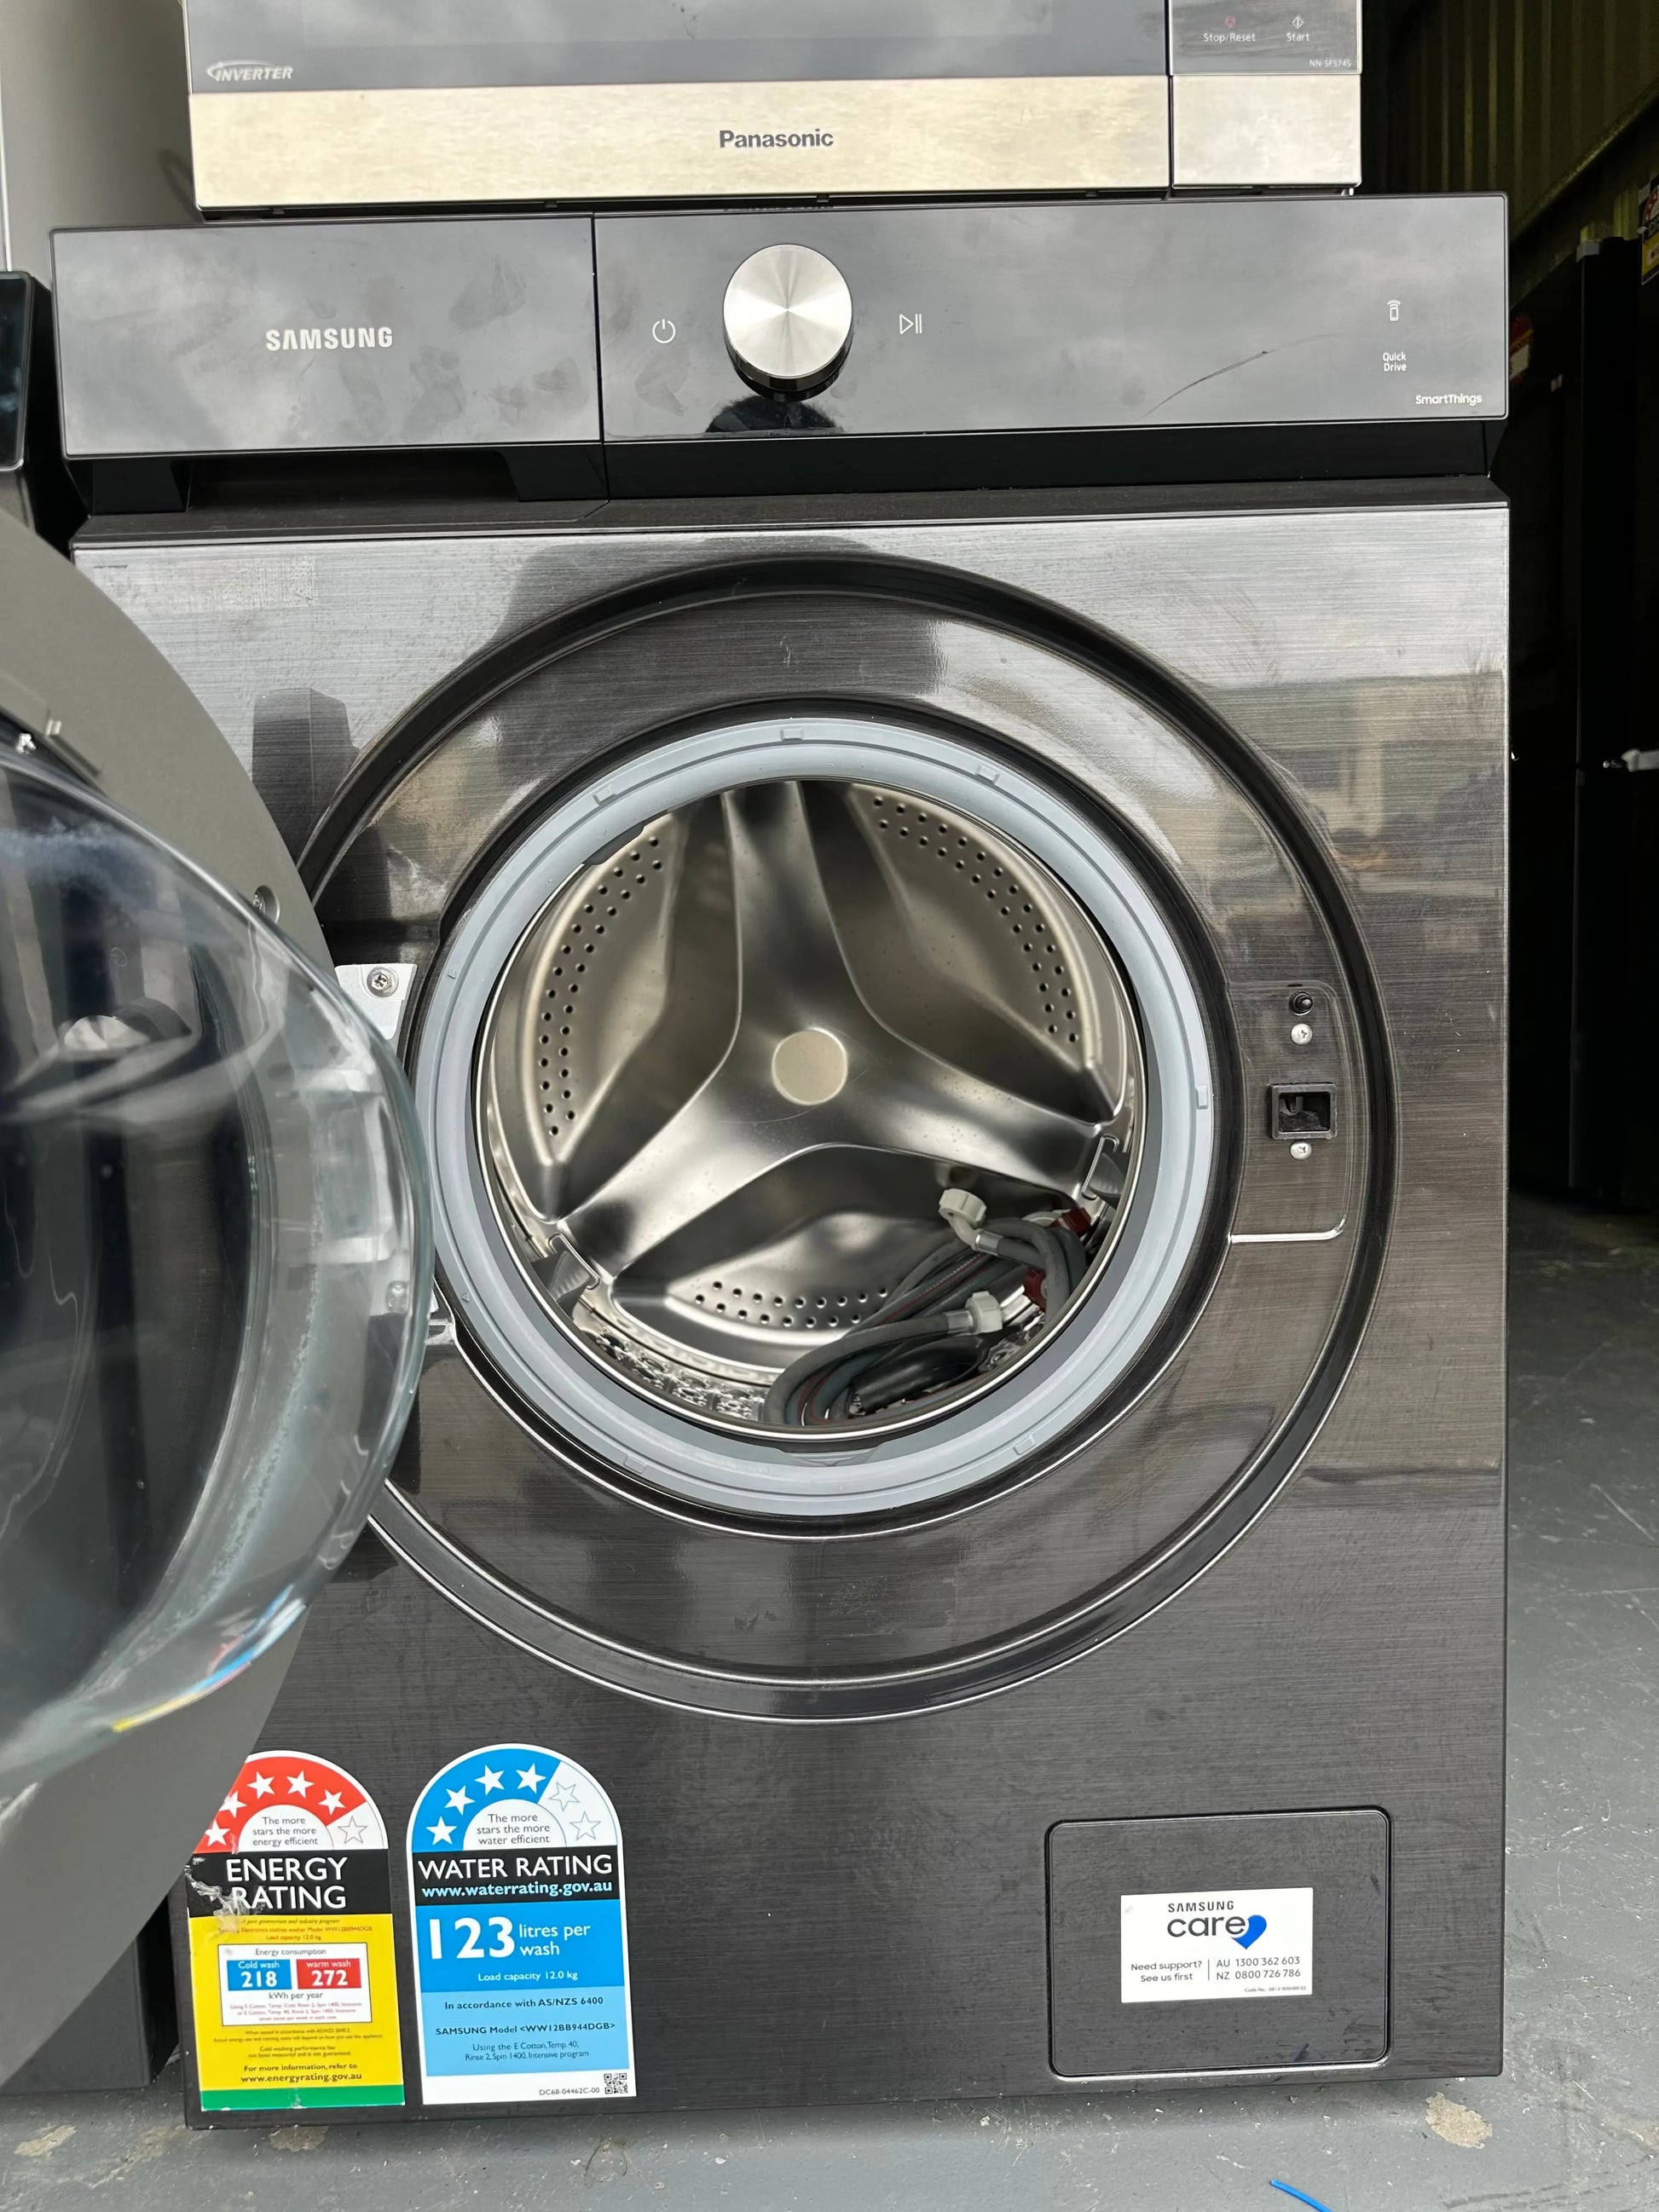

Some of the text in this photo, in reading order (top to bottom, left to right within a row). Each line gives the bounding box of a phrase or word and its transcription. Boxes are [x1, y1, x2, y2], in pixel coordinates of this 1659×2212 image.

[1203, 32, 1256, 43] Stop/Reset
[1286, 32, 1309, 42] Start
[211, 64, 293, 82] INVERTER
[719, 129, 834, 148] Panasonic
[266, 326, 393, 351] SAMSUNG
[1382, 351, 1406, 362] Quick
[1384, 362, 1407, 372] Drive
[1415, 393, 1483, 407] SmartThings
[263, 1816, 280, 1825] The
[488, 1814, 538, 1822] The more
[276, 1827, 291, 1835] the
[477, 1825, 500, 1834] stars
[504, 1824, 521, 1834] the
[253, 1837, 318, 1847] energy efficient
[478, 1835, 551, 1845] water efficient
[226, 1857, 348, 1882] ENERGY
[418, 1854, 613, 1880] WATER RATING
[421, 1881, 613, 1897] www.waterrating.gov.au
[231, 1886, 346, 1909] RATING
[1168, 1900, 1234, 1913] SAMSUNG
[1167, 1915, 1246, 1938] care
[429, 1916, 591, 1960] 123 litres per
[281, 1948, 327, 1956] consumption
[519, 1941, 560, 1956] wash
[238, 1961, 280, 1969] Cold wash
[330, 1960, 351, 1968] wash
[1130, 1961, 1202, 1972] Need support?
[1216, 1956, 1300, 1967] AU 1300 362 603
[240, 1971, 277, 1988] 218
[311, 1970, 348, 1986] 272
[477, 1970, 578, 1982] Load capacity 12.0 kg
[1141, 1973, 1159, 1983] See
[1174, 1972, 1194, 1981] first
[1216, 1969, 1301, 1980] NZ 0800 726 786
[291, 1992, 303, 2001] per
[307, 1991, 323, 2000] year
[444, 1996, 604, 2010] In accordance with AS/NZS 6400
[436, 2022, 616, 2036] SAMSUNG Model <WW12BB944DGB>
[472, 2043, 495, 2053] Using
[465, 2053, 483, 2061] Rinse
[492, 2053, 507, 2061] Spin
[559, 2050, 589, 2059] program
[281, 2064, 328, 2072] information,
[241, 2072, 362, 2083] www.energyrating.gov.au
